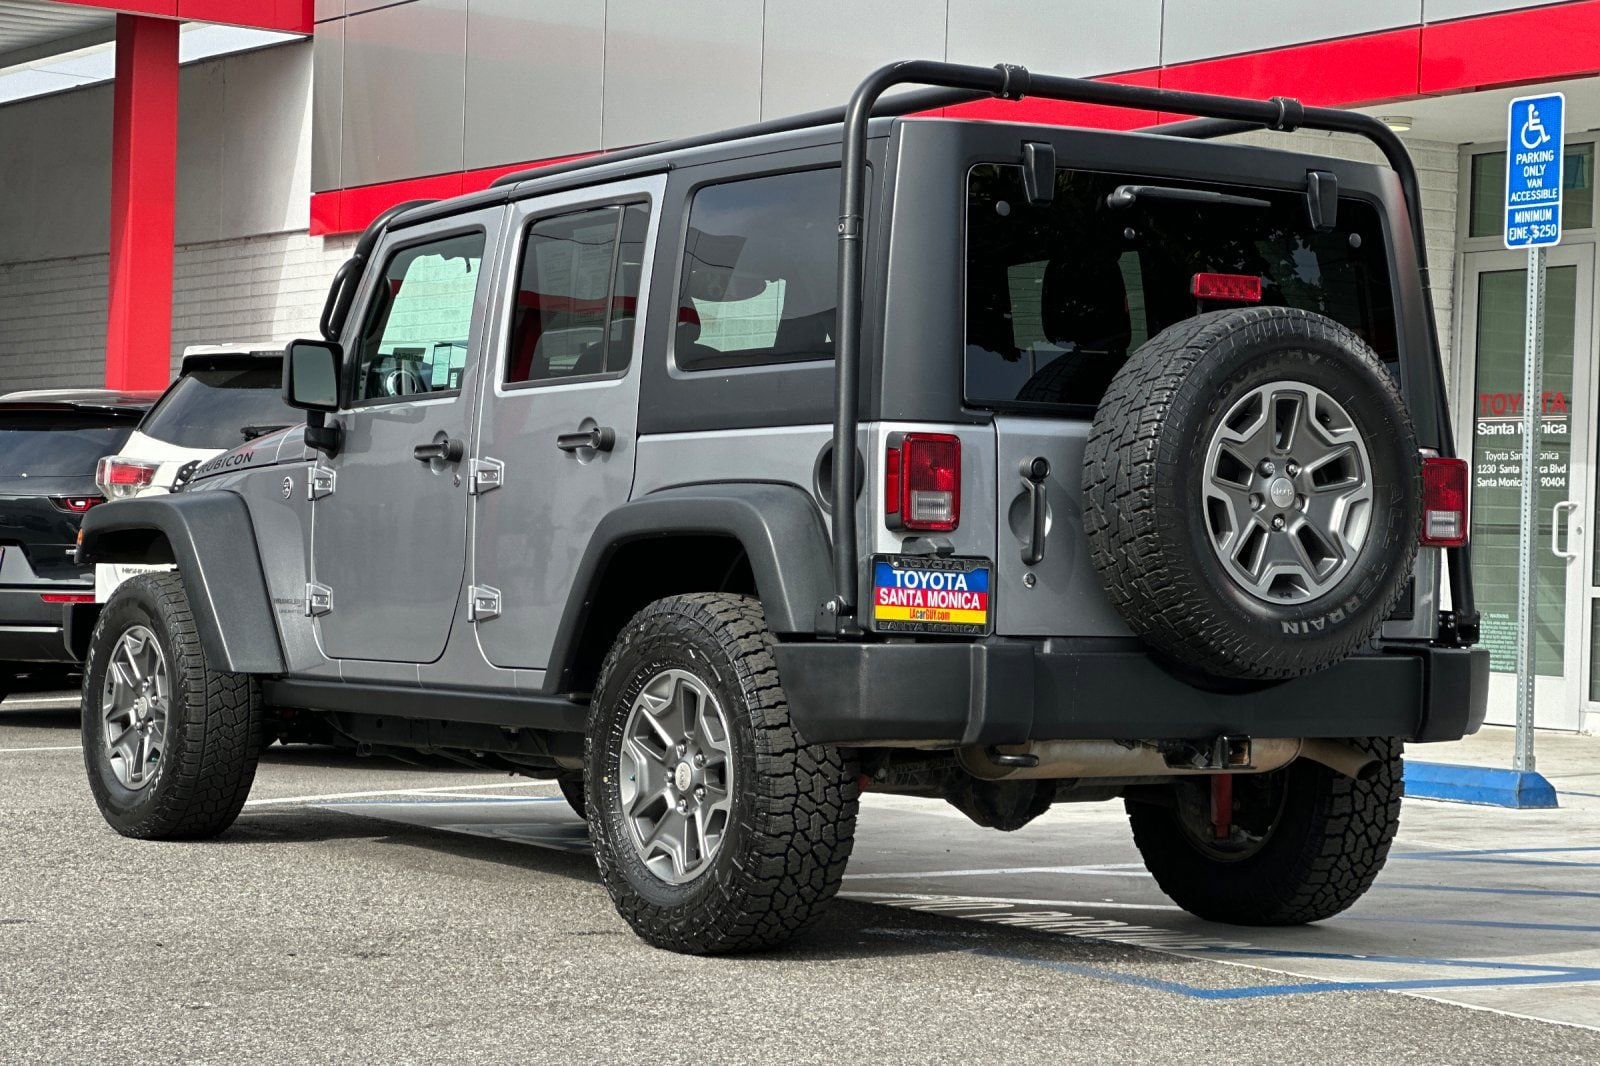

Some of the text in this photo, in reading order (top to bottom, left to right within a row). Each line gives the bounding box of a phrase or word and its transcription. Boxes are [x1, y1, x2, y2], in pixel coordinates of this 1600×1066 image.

[1516, 150, 1554, 164] PARKING
[1523, 164, 1546, 177] ONLY
[1526, 178, 1543, 187] VAN
[1510, 188, 1558, 202] ACCESSIBLE
[1514, 208, 1553, 224] MINIMUM
[1509, 224, 1557, 241] FINE $250
[1478, 390, 1567, 415] TOYTA
[1477, 421, 1567, 435] Santa Mnica
[198, 451, 255, 474] RUBICON
[1485, 451, 1508, 462] Toyota
[1477, 464, 1496, 474] 1230
[1499, 464, 1520, 474] Santa
[1549, 463, 1567, 474] Blvd
[1477, 477, 1497, 487] Santa
[1541, 477, 1566, 487] 90404
[892, 569, 968, 591] TOYOTA
[879, 588, 981, 610] SANTA MONICA
[909, 607, 951, 621] LAcarGUY.com
[878, 621, 981, 634] SANTA MONICA
